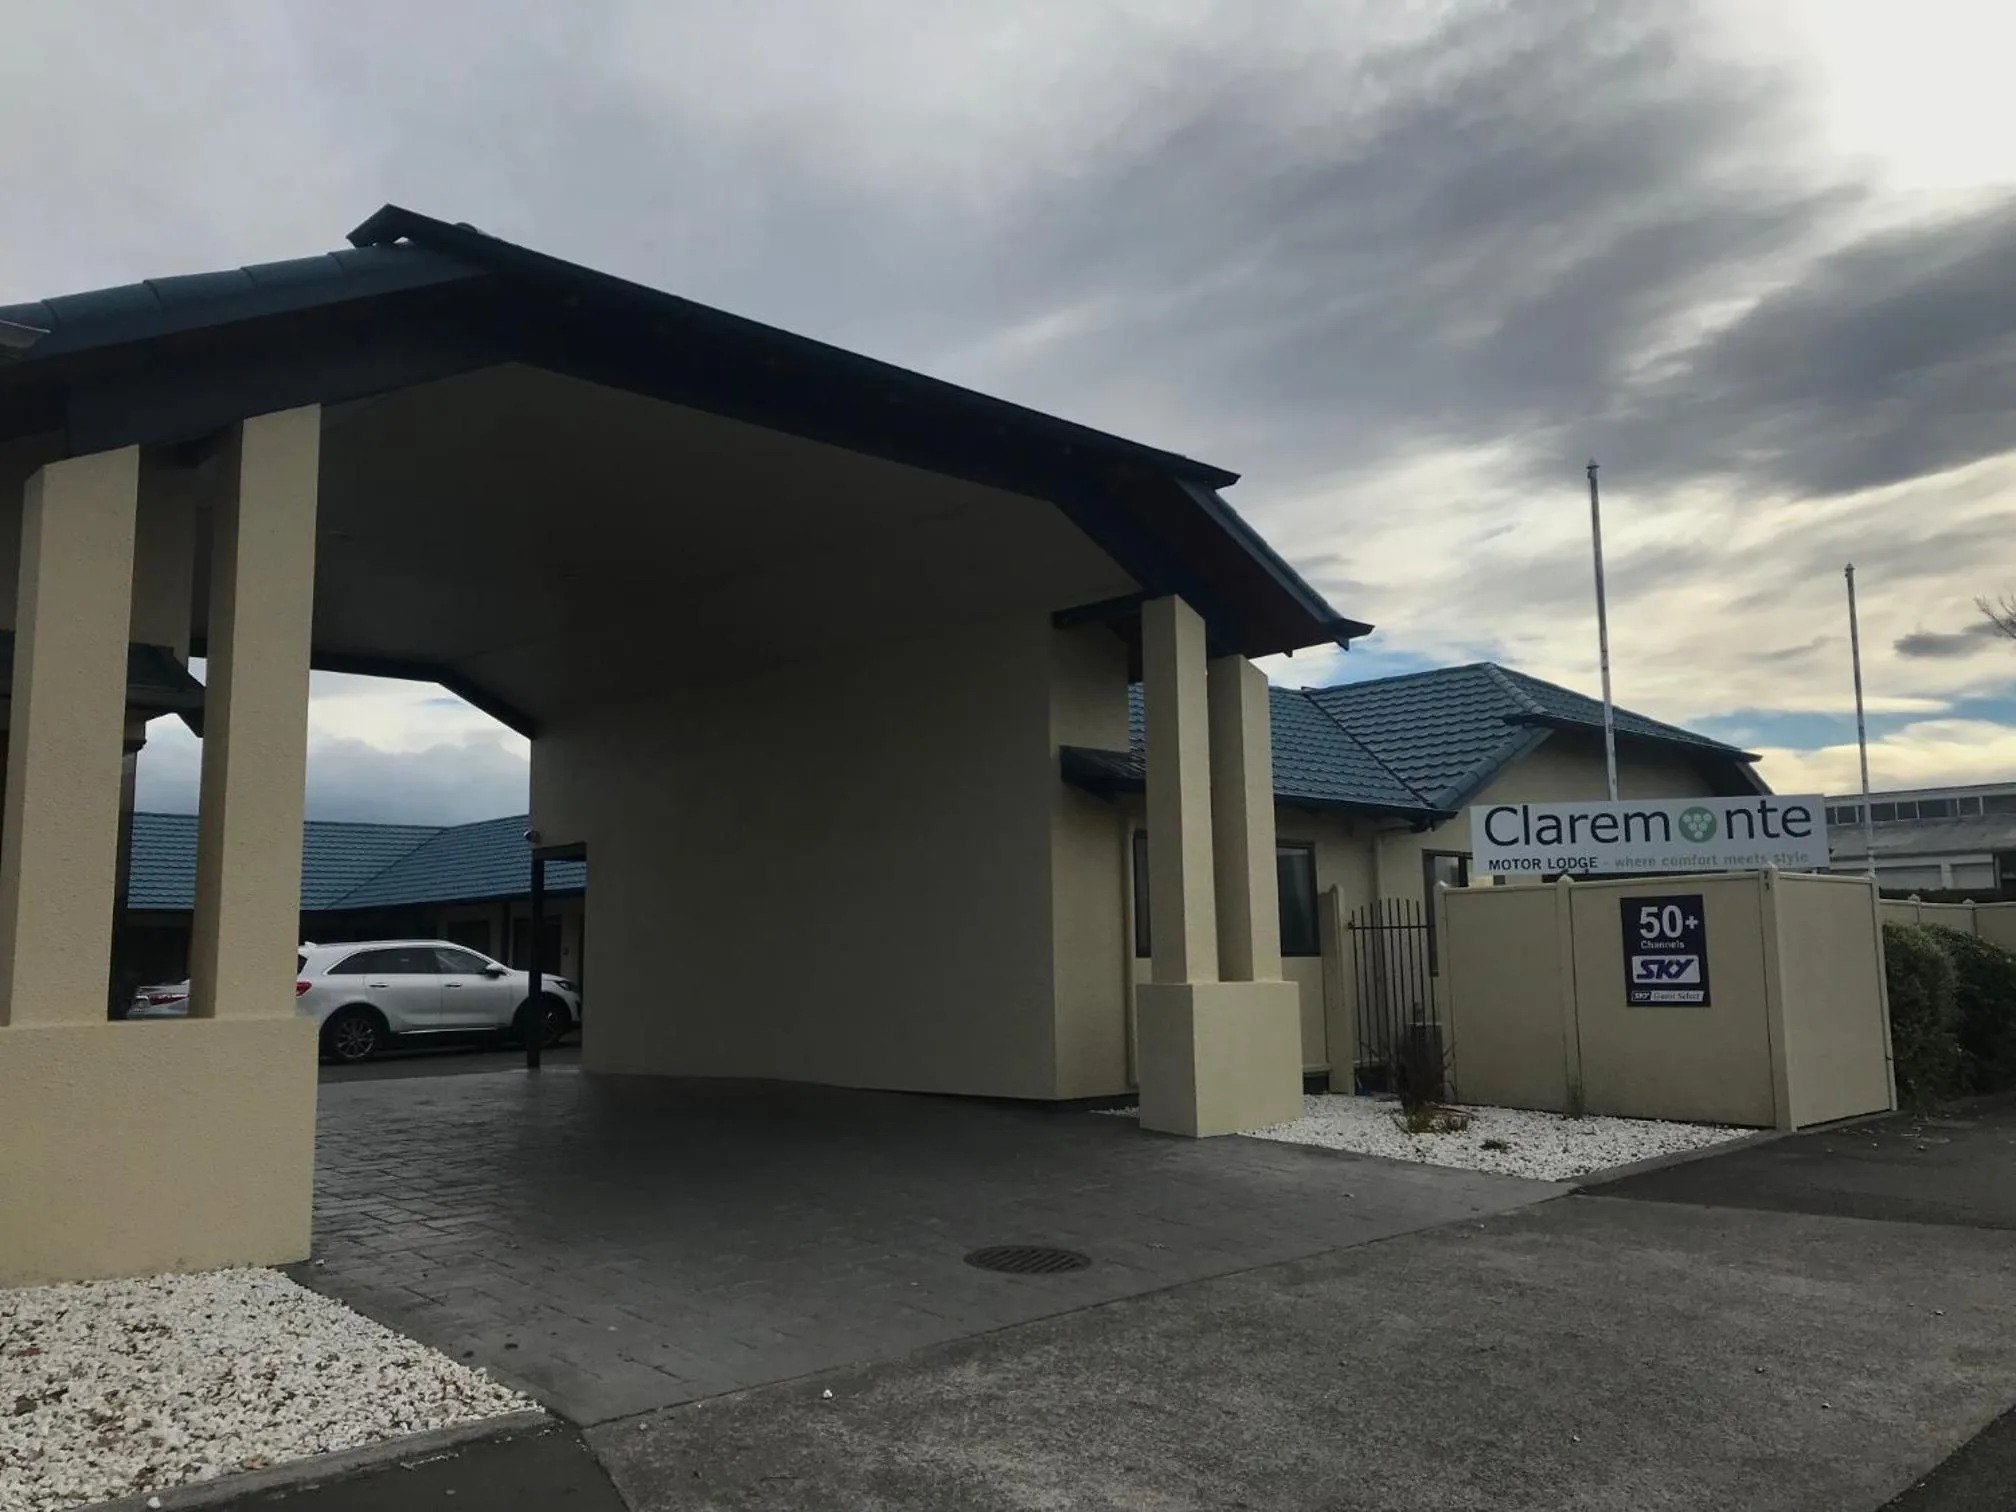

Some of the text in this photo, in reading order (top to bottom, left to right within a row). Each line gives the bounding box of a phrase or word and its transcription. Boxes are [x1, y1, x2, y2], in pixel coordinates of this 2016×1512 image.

[1488, 850, 1808, 871] MOTOR LODGE where comfort meets style
[1639, 905, 1699, 938] 50+
[1640, 940, 1685, 949] Channels
[1636, 958, 1695, 980] SKY
